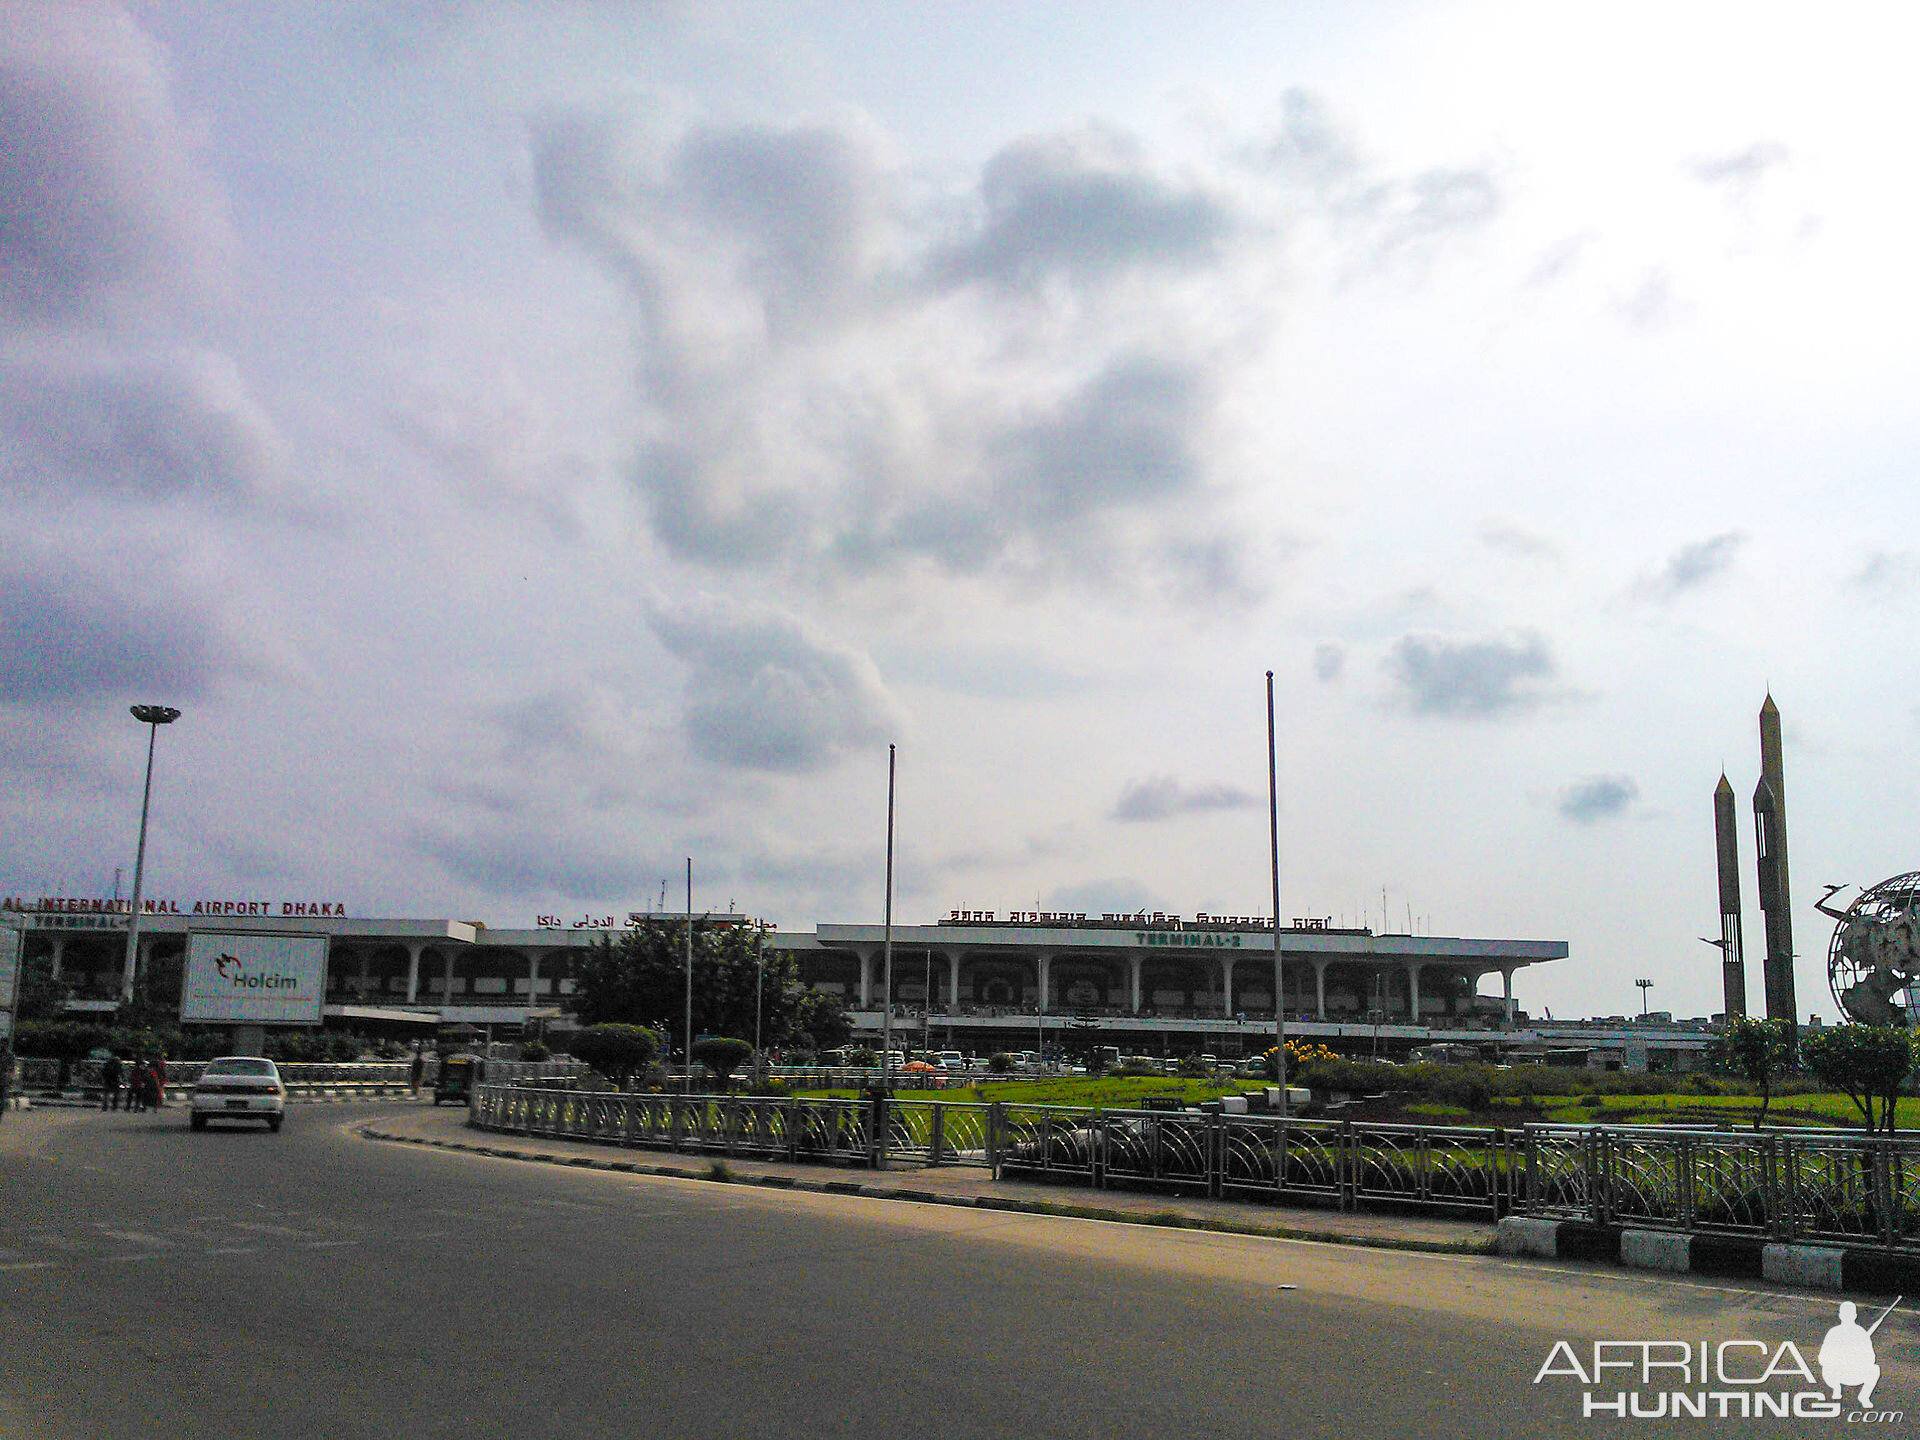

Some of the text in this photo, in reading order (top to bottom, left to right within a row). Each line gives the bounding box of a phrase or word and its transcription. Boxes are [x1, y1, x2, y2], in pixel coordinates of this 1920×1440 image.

[38, 898, 179, 913] INTERNATINAL
[193, 901, 270, 914] AIRPORT
[282, 902, 346, 917] DHAKA
[1136, 932, 1241, 947] TERMINAL-2
[234, 973, 297, 989] Holcim
